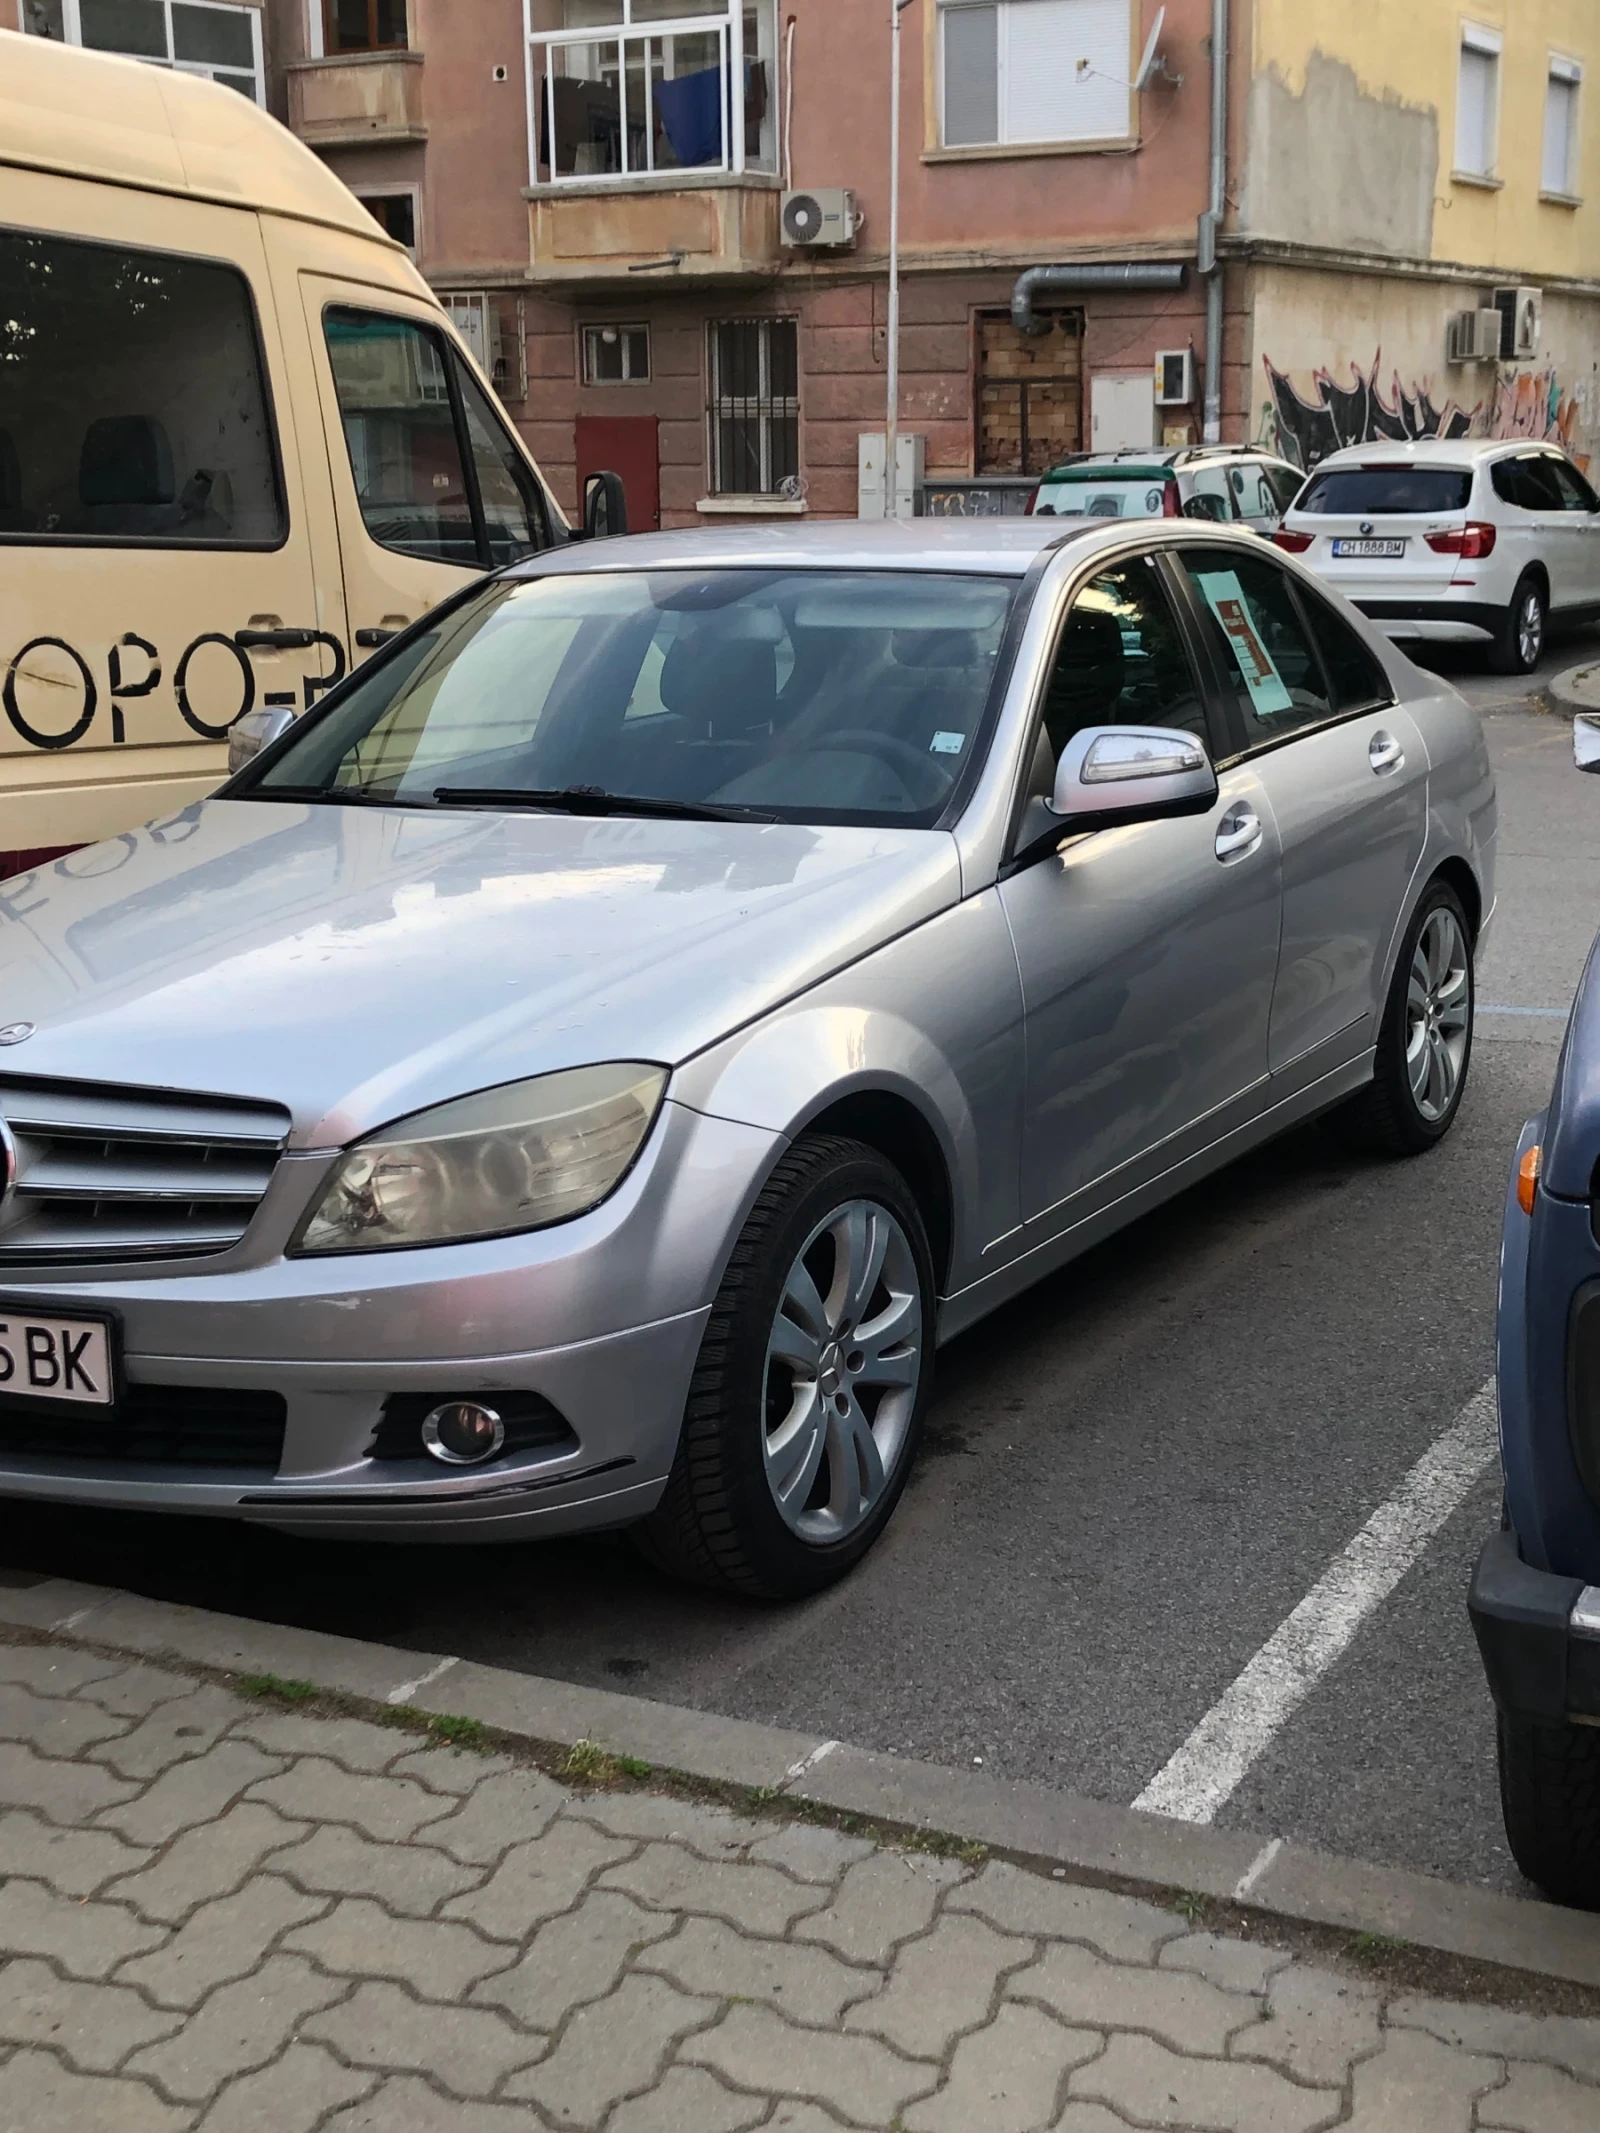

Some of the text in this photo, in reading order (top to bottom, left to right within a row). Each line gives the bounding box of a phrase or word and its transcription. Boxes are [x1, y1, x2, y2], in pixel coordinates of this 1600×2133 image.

[1341, 541, 1402, 553] CH 1888 BM
[25, 1326, 99, 1393] BK
